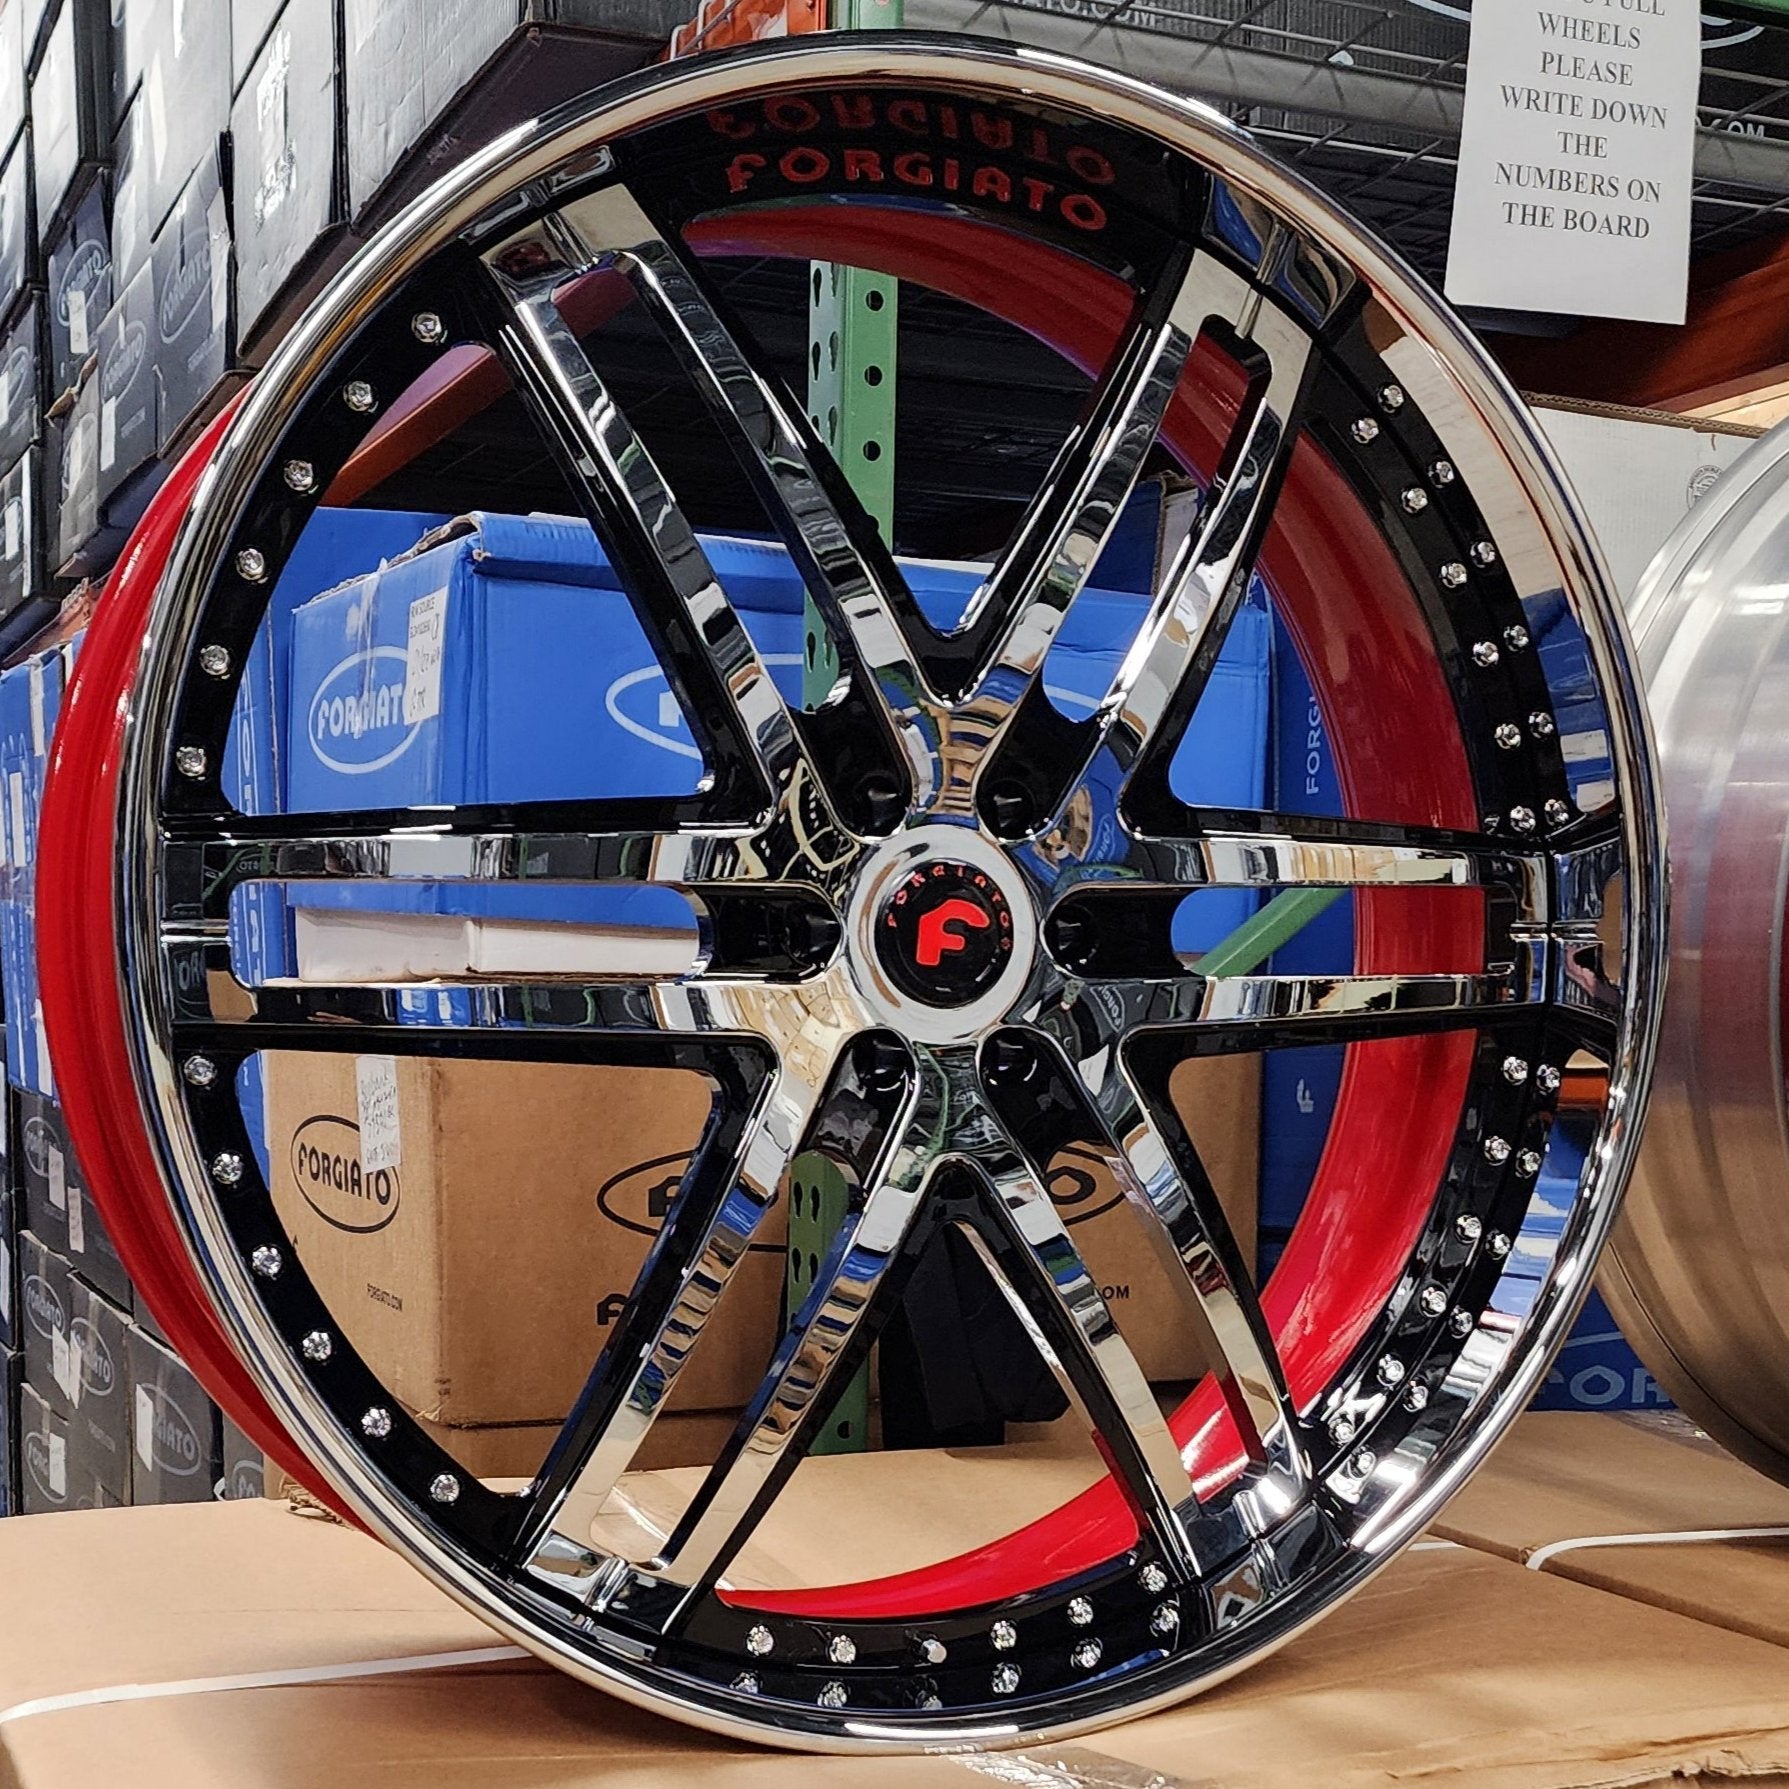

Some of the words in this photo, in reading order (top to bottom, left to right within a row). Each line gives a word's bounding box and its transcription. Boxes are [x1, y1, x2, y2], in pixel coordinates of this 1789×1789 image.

[1537, 11, 1642, 50] WHEELS
[1539, 51, 1634, 86] PLEASE
[1499, 84, 1583, 118] WRITE
[1590, 97, 1669, 130] DOWN
[1556, 131, 1609, 159] THE
[724, 146, 1108, 231] FORGIATO
[1494, 161, 1620, 199] NUMBERS
[1626, 177, 1663, 203] ON
[1502, 201, 1555, 229] THE
[1562, 207, 1651, 240] BOARD
[915, 897, 991, 967] F
[297, 1141, 392, 1206] FORGIATO
